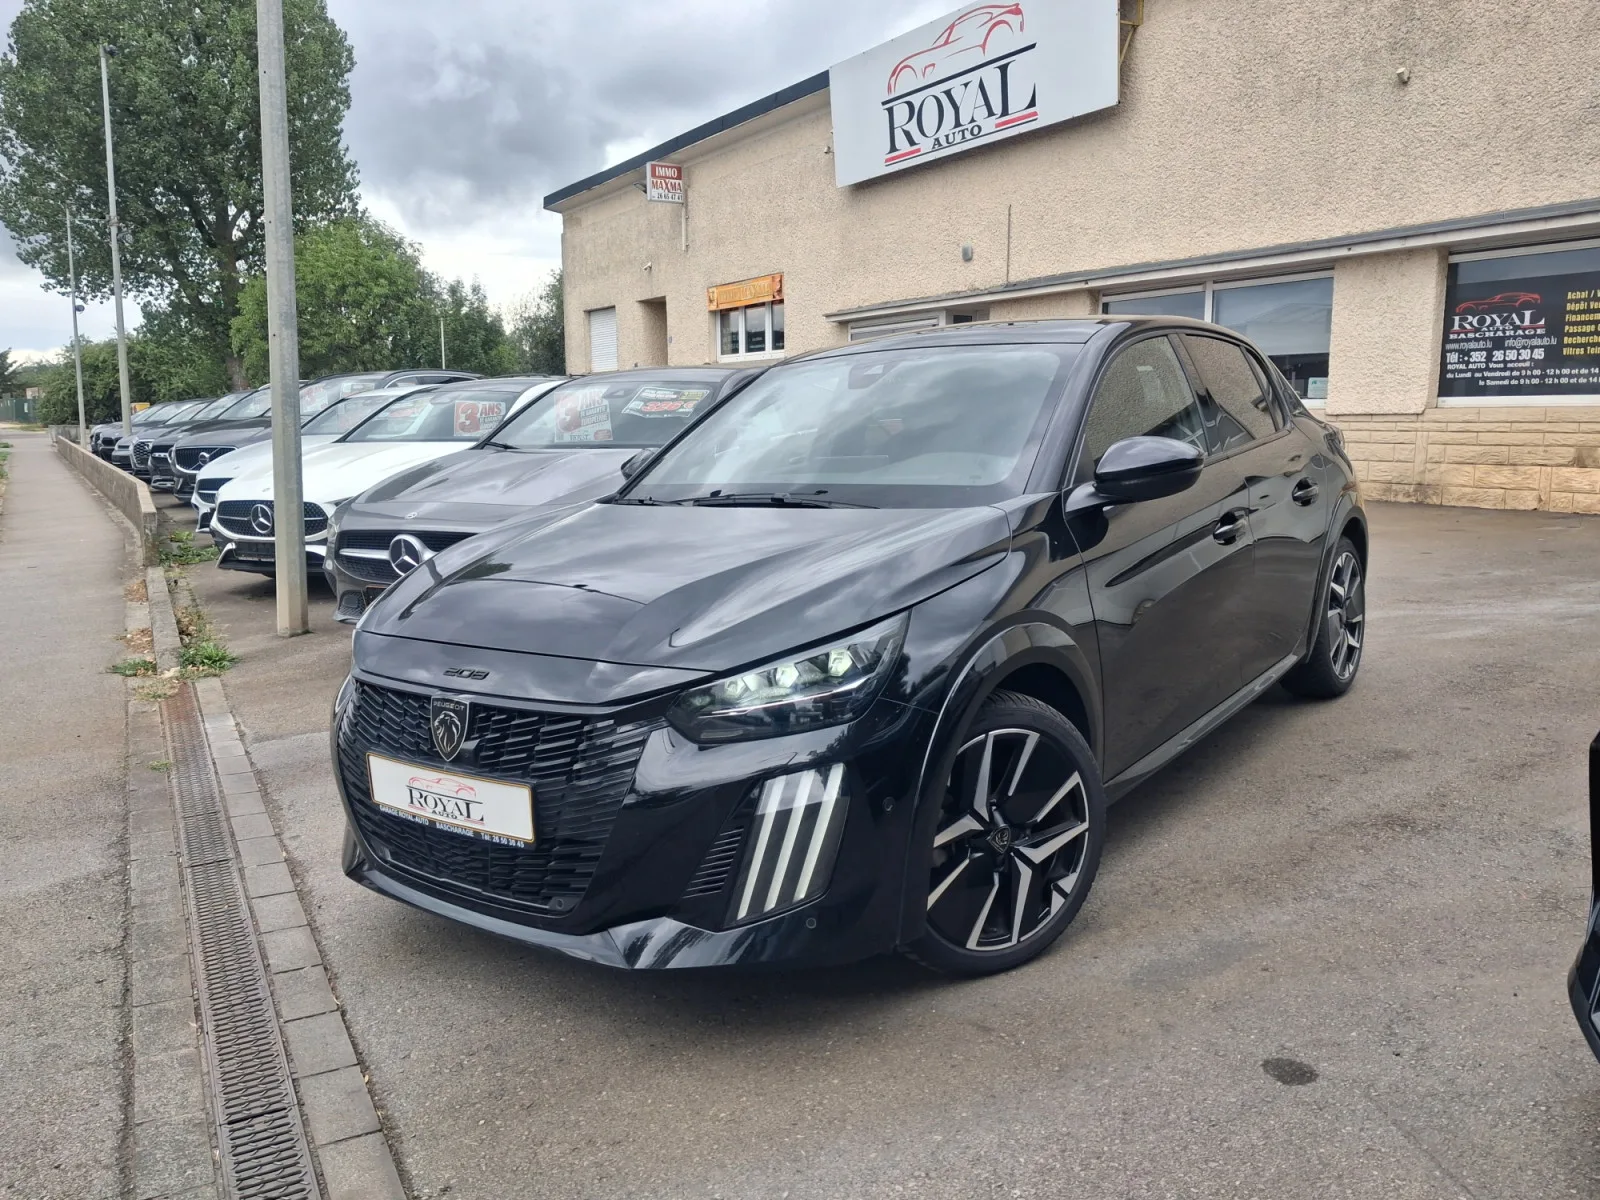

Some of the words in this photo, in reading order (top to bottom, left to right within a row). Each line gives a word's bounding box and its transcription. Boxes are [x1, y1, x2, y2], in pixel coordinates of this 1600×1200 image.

[883, 59, 1037, 155] ROYAL
[931, 124, 983, 150] AUTO
[655, 166, 678, 178] IMMO
[651, 179, 683, 193] MAXMA
[1567, 290, 1588, 300] Achat
[1451, 309, 1545, 330] ROYAL
[1449, 328, 1546, 340] BASCHARAGE
[1564, 324, 1596, 333] Passage
[1445, 339, 1493, 351] www.royalauto.lu
[1505, 336, 1557, 349] info@royalauto.lu
[1492, 350, 1505, 361] 26
[1505, 349, 1518, 361] 50
[1518, 348, 1531, 360] 30
[1531, 348, 1545, 360] 45
[1562, 346, 1585, 356] Vitres
[480, 402, 502, 417] ANS
[458, 402, 481, 433] 3
[443, 667, 490, 681] 208
[433, 700, 465, 711] PEUGEOT
[408, 788, 485, 822] ROYAL
[432, 809, 458, 819] AUTO
[436, 821, 475, 837] BASCHARAGE
[492, 835, 500, 843] 26
[516, 840, 525, 849] 45
